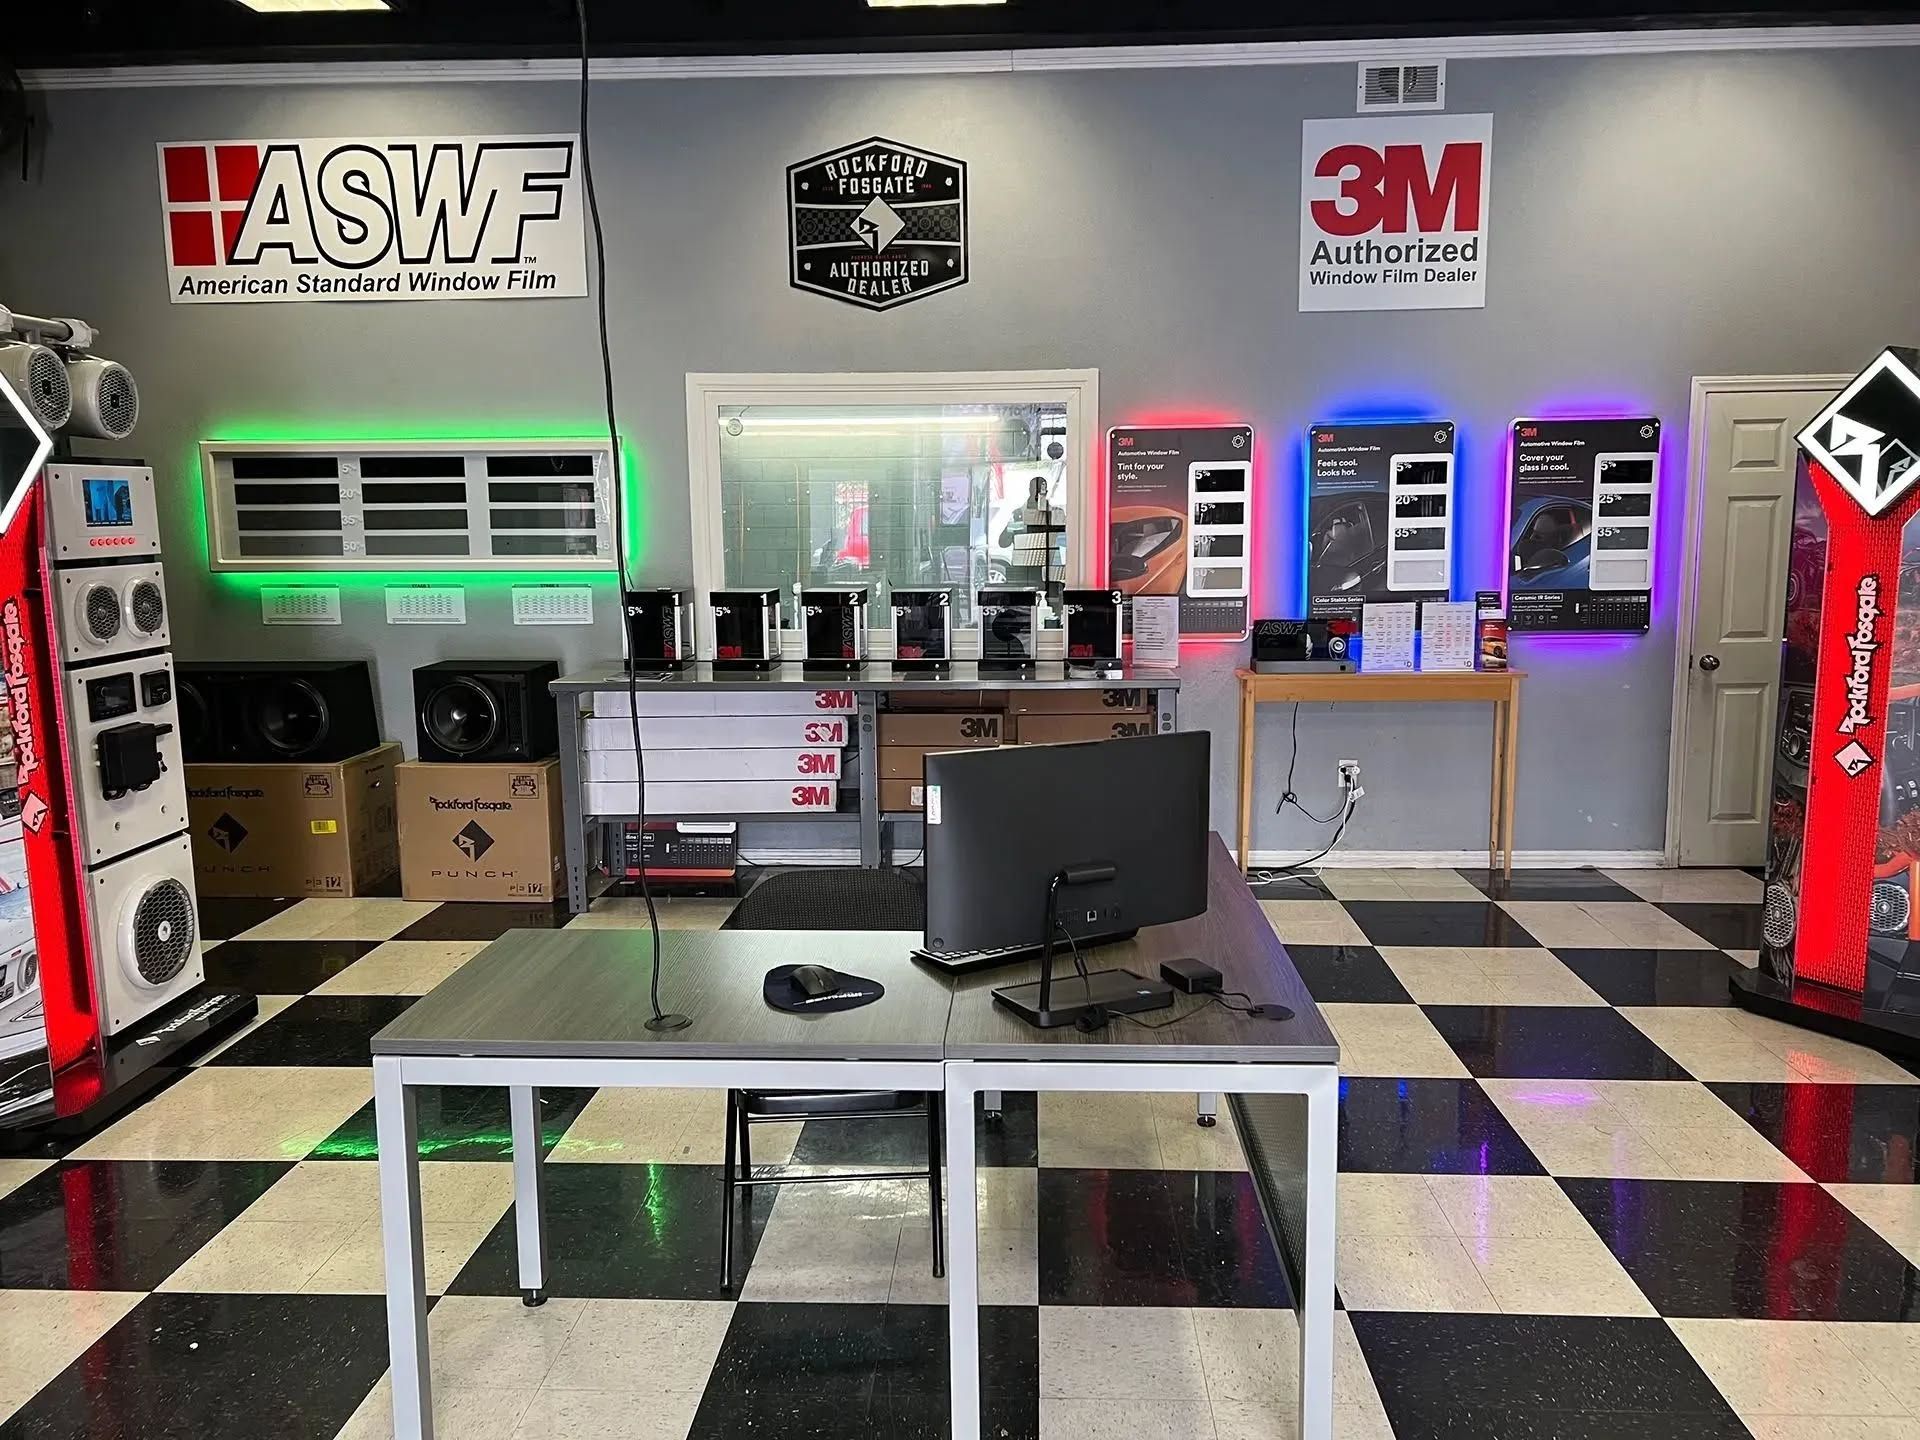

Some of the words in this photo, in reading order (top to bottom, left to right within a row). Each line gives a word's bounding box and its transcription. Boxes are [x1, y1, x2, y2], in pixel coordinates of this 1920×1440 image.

[825, 153, 928, 181] ROCKFORD
[839, 176, 915, 195] FOSGATE
[1310, 142, 1483, 236] 3M
[226, 141, 573, 269] ASWF
[1310, 237, 1478, 265] Authorized
[829, 260, 929, 278] AUTHORIZED
[178, 275, 288, 295] American
[296, 272, 400, 293] Standard
[408, 270, 499, 292] Window
[507, 270, 556, 290] Film
[1309, 270, 1378, 285] Window
[1382, 269, 1418, 284] Film
[1425, 268, 1477, 283] Dealer
[847, 277, 912, 296] DEALER
[1318, 433, 1334, 443] 3M
[1521, 427, 1537, 437] 3M
[1118, 437, 1134, 447] 3M
[1317, 459, 1338, 467] Feels
[1338, 458, 1358, 466] cool.
[1519, 454, 1544, 462] Cover
[1545, 454, 1564, 463] your
[1117, 462, 1133, 470] Tint
[1134, 462, 1146, 470] for
[1146, 464, 1164, 472] your
[1317, 468, 1340, 477] Looks
[1341, 467, 1357, 476] hot.
[1396, 462, 1412, 472] 5%
[1519, 464, 1540, 473] glass
[1541, 463, 1549, 471] in
[1550, 462, 1570, 471] cool.
[1117, 472, 1138, 481] style.
[1195, 470, 1211, 480] 5%
[1396, 495, 1418, 505] 20%
[1600, 494, 1622, 504] 25%
[1395, 528, 1418, 538] 35%
[1597, 527, 1621, 538] 35%
[671, 593, 680, 606] 1
[759, 593, 768, 606] 1
[848, 592, 859, 605] 2
[939, 593, 949, 606] 2
[1111, 591, 1122, 604] 3
[628, 606, 643, 617] 5%
[715, 606, 731, 617] 5%
[807, 605, 823, 617] 5%
[896, 606, 912, 616] 5%
[1067, 604, 1083, 615] 5%
[1847, 577, 1881, 650] Fosgate
[4, 602, 29, 688] Fosgate
[1070, 644, 1093, 657] 3M
[719, 646, 742, 658] 3M
[1102, 688, 1141, 708] 3M
[1838, 650, 1872, 733] Rockford
[815, 690, 853, 709] 3M
[960, 717, 998, 739] 3M
[1111, 722, 1150, 739] 3M
[11, 686, 39, 785] Rockford
[797, 754, 835, 774] 3M
[791, 786, 830, 806] 3M
[429, 796, 473, 812] Rockford
[474, 797, 511, 813] Fosgate
[431, 870, 513, 878] PUNCH
